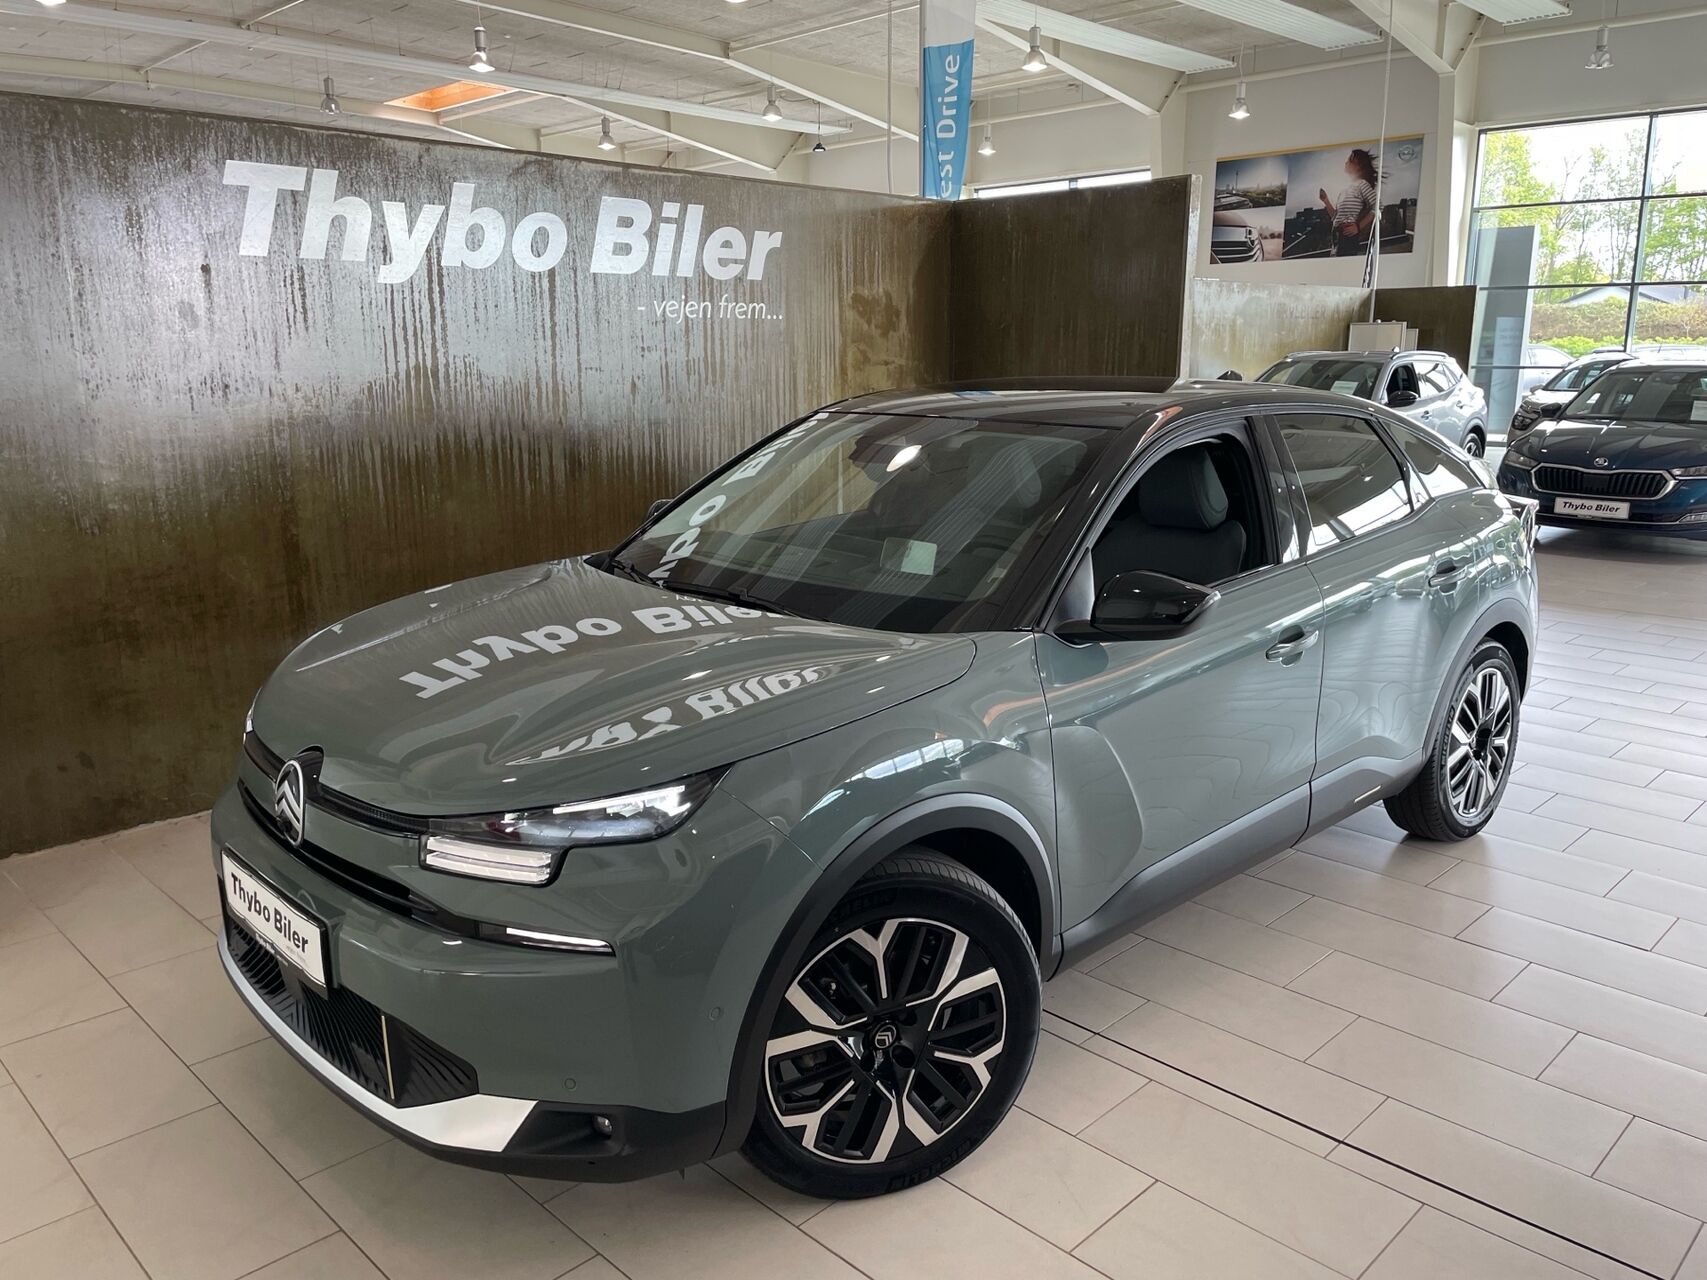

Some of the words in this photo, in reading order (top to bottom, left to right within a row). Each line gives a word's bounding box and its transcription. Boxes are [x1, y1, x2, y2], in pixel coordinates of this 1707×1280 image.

[937, 54, 960, 139] Drive
[938, 151, 955, 199] est
[222, 159, 568, 284] Thybo
[590, 195, 782, 281] Biler
[653, 294, 712, 324] vejen
[719, 294, 783, 319] frem...
[1563, 501, 1593, 511] Thybo
[1595, 504, 1620, 513] Biler
[231, 871, 271, 923] Thybo
[274, 907, 309, 953] Biler
